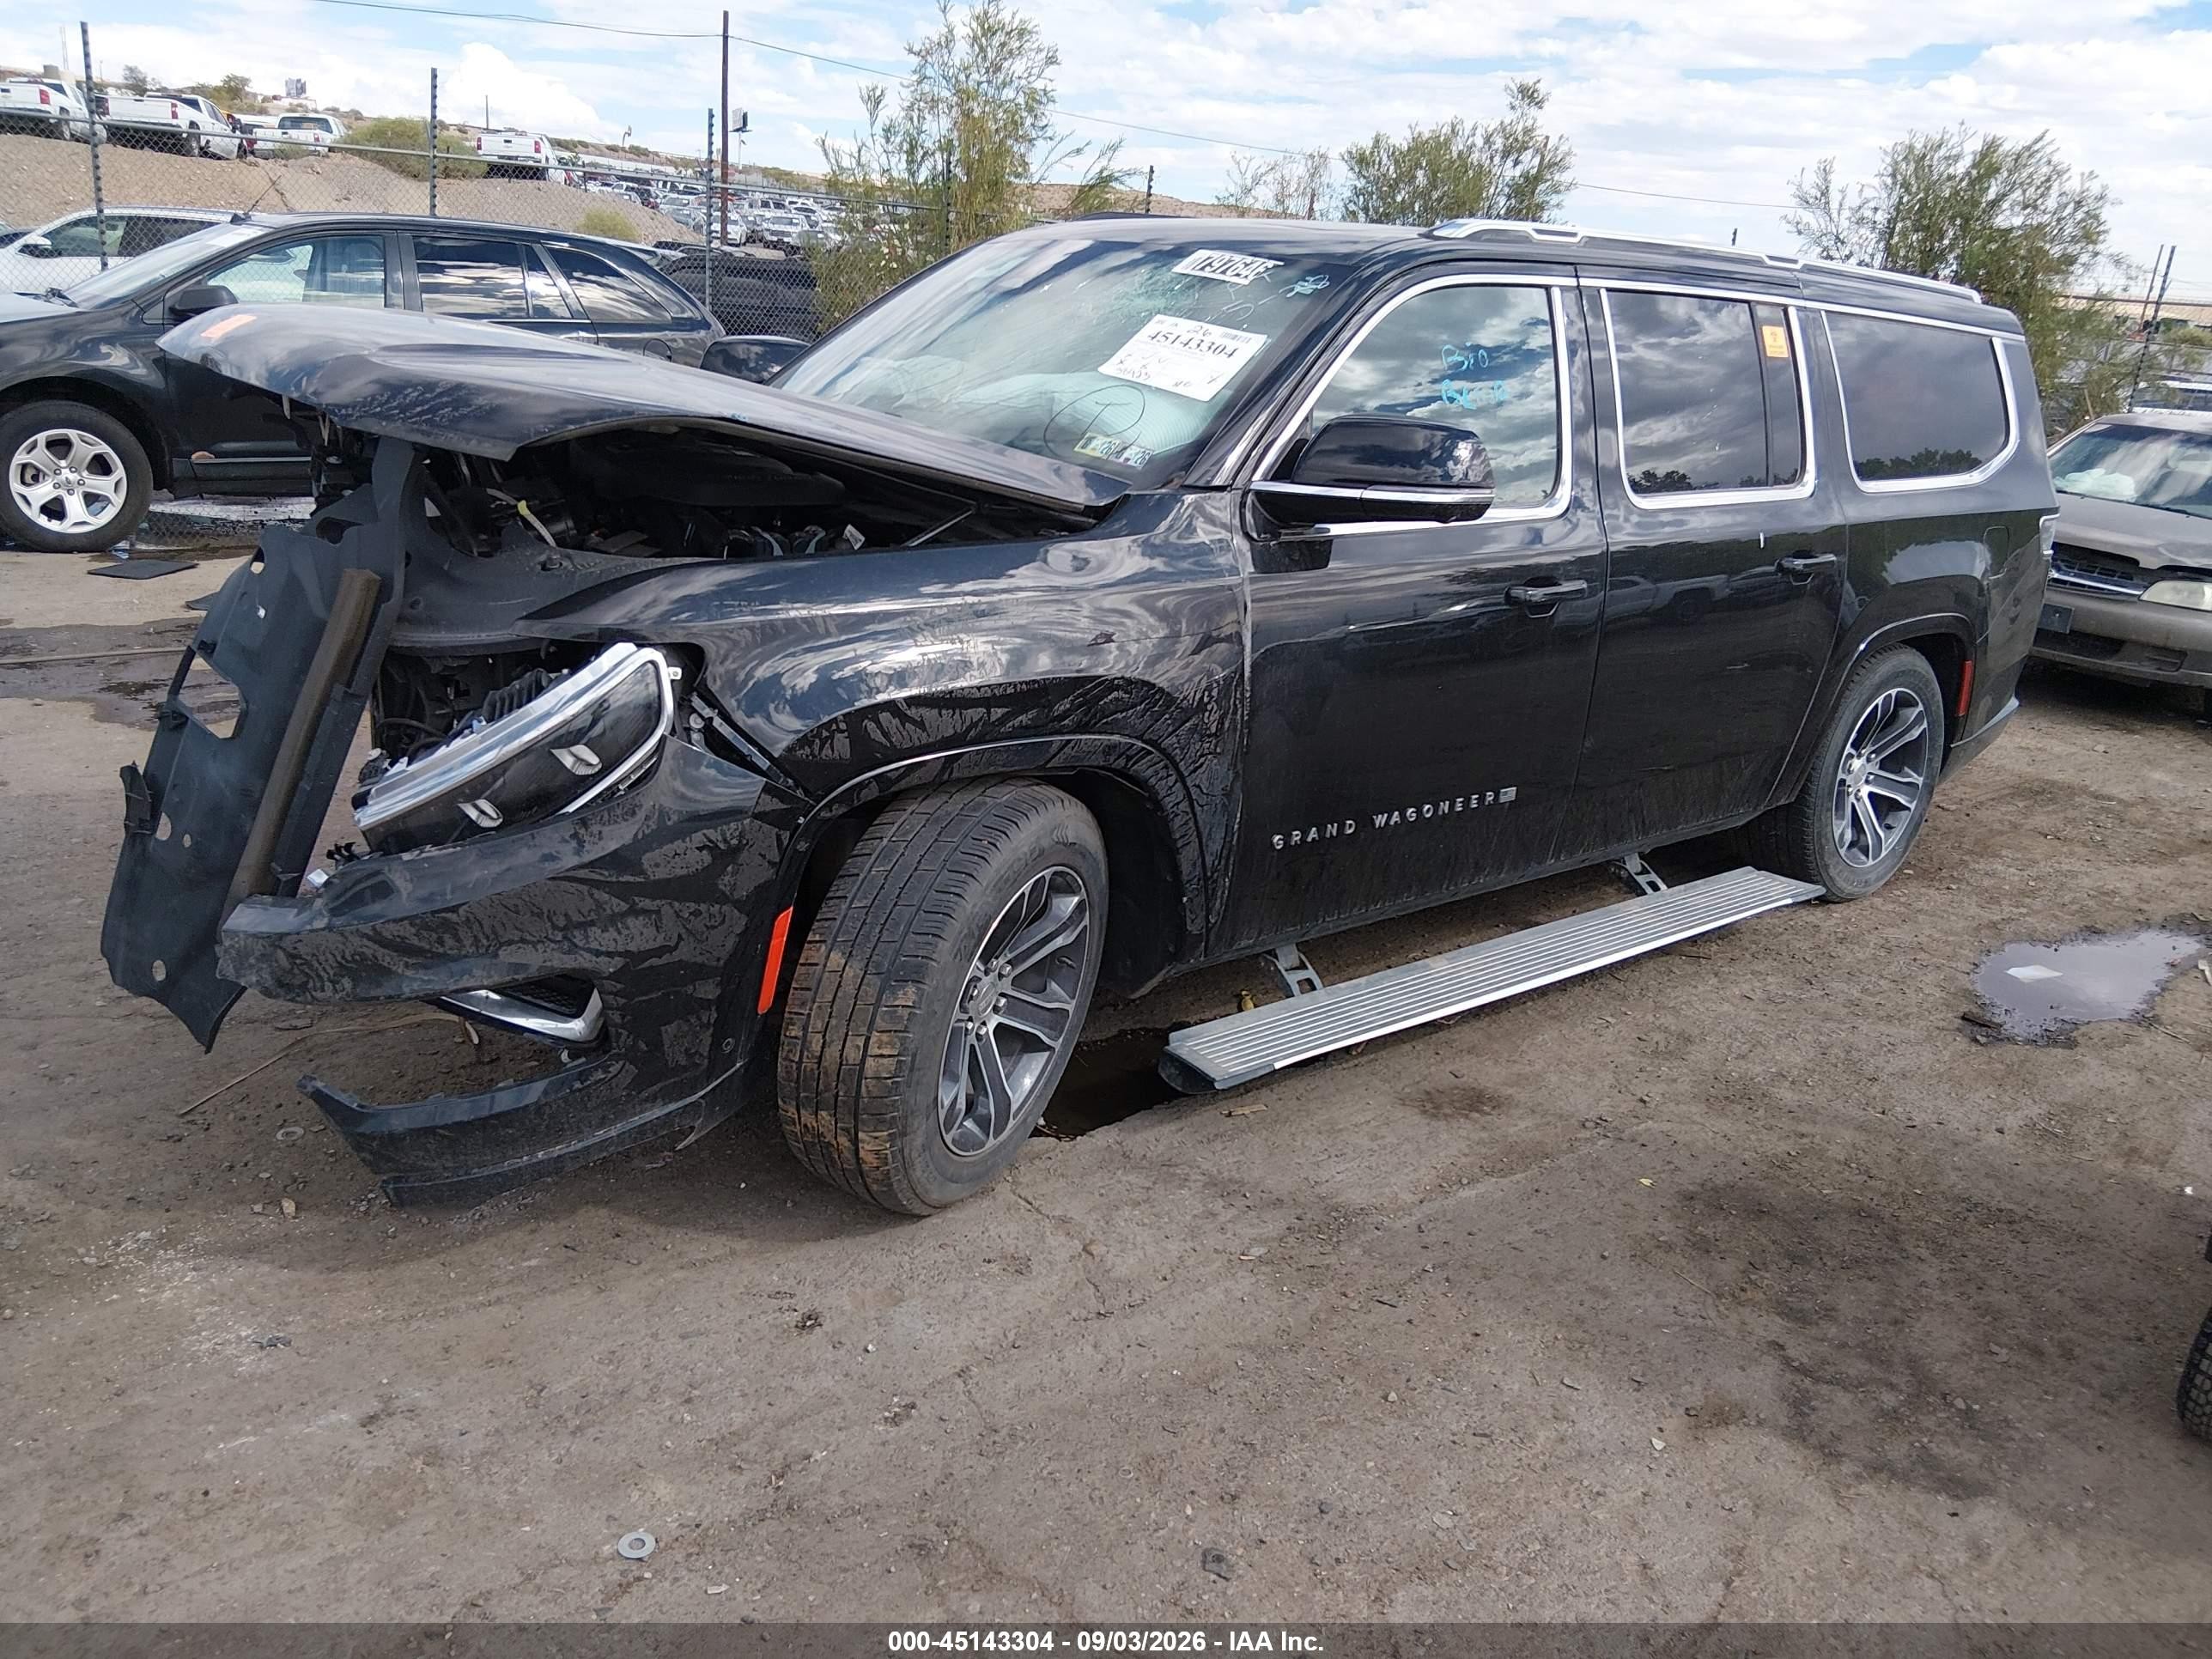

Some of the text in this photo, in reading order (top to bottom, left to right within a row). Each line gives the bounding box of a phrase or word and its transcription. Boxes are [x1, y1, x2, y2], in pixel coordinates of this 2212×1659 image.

[1147, 330, 1238, 359] 45143304
[1271, 791, 1497, 850] GRAND WAGONEER
